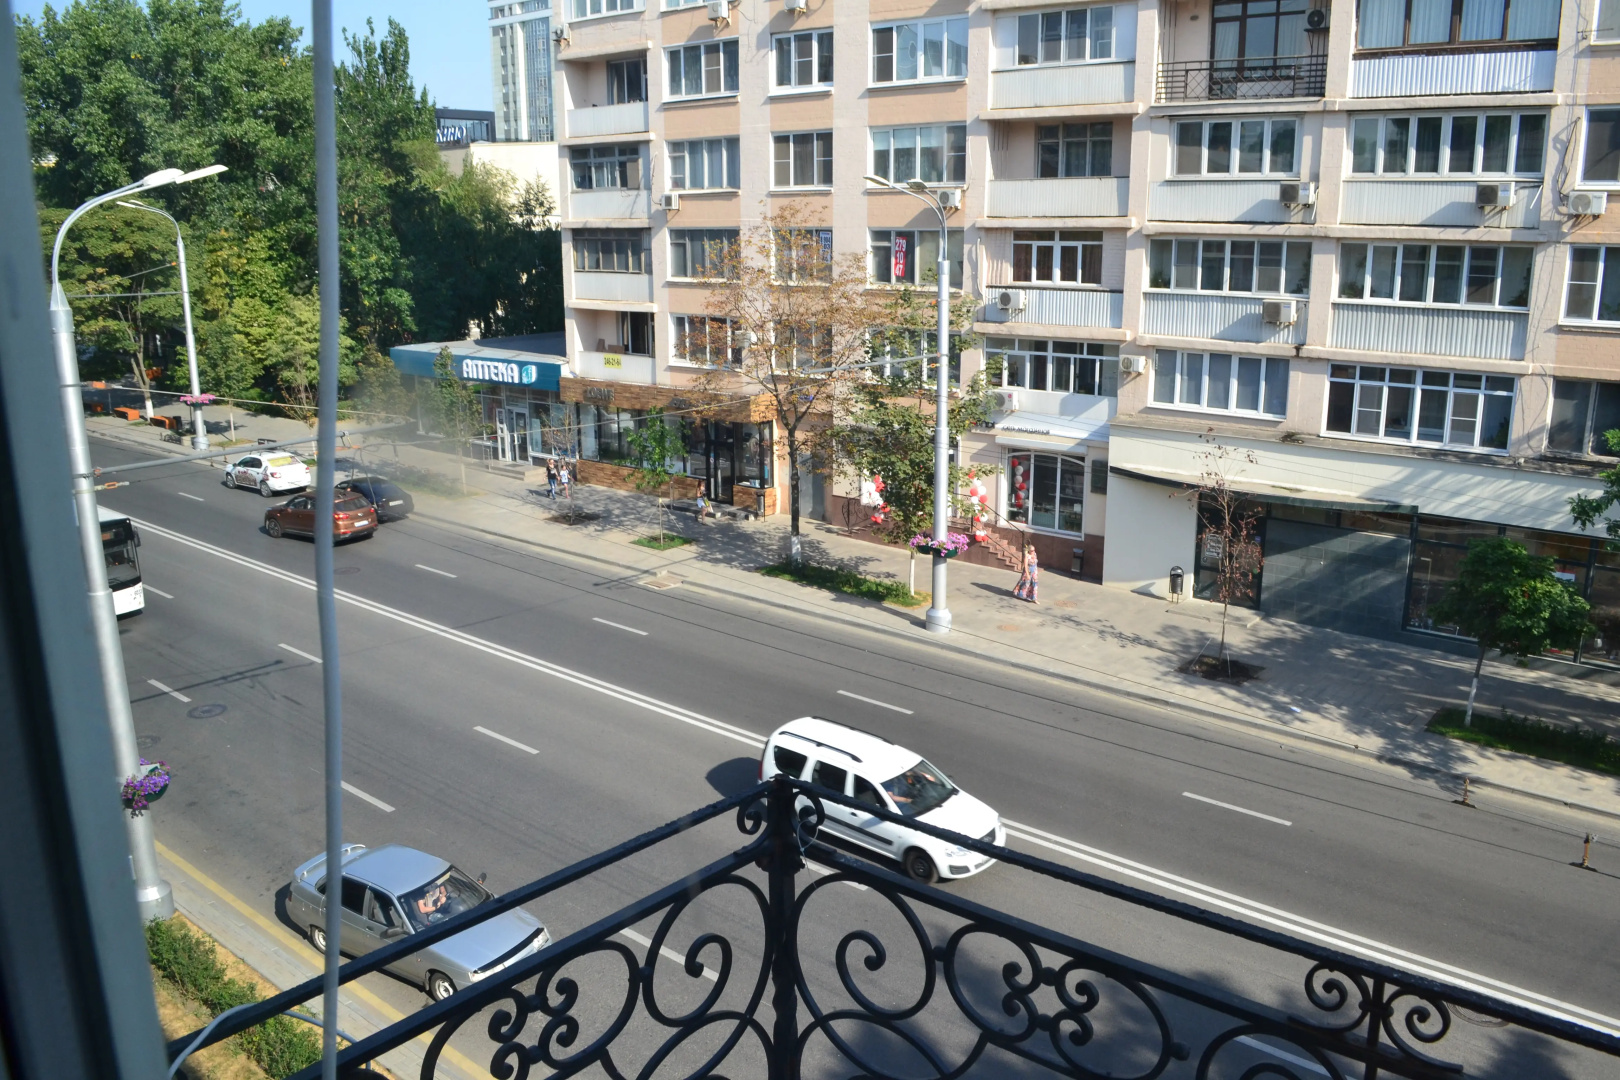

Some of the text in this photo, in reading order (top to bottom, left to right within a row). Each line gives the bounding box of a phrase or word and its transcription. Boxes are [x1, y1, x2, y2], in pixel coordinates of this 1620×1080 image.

[436, 126, 467, 142] КИНО
[895, 238, 907, 252] 279
[896, 251, 904, 264] 10
[895, 263, 903, 276] 47
[462, 358, 520, 384] АПТЕКА
